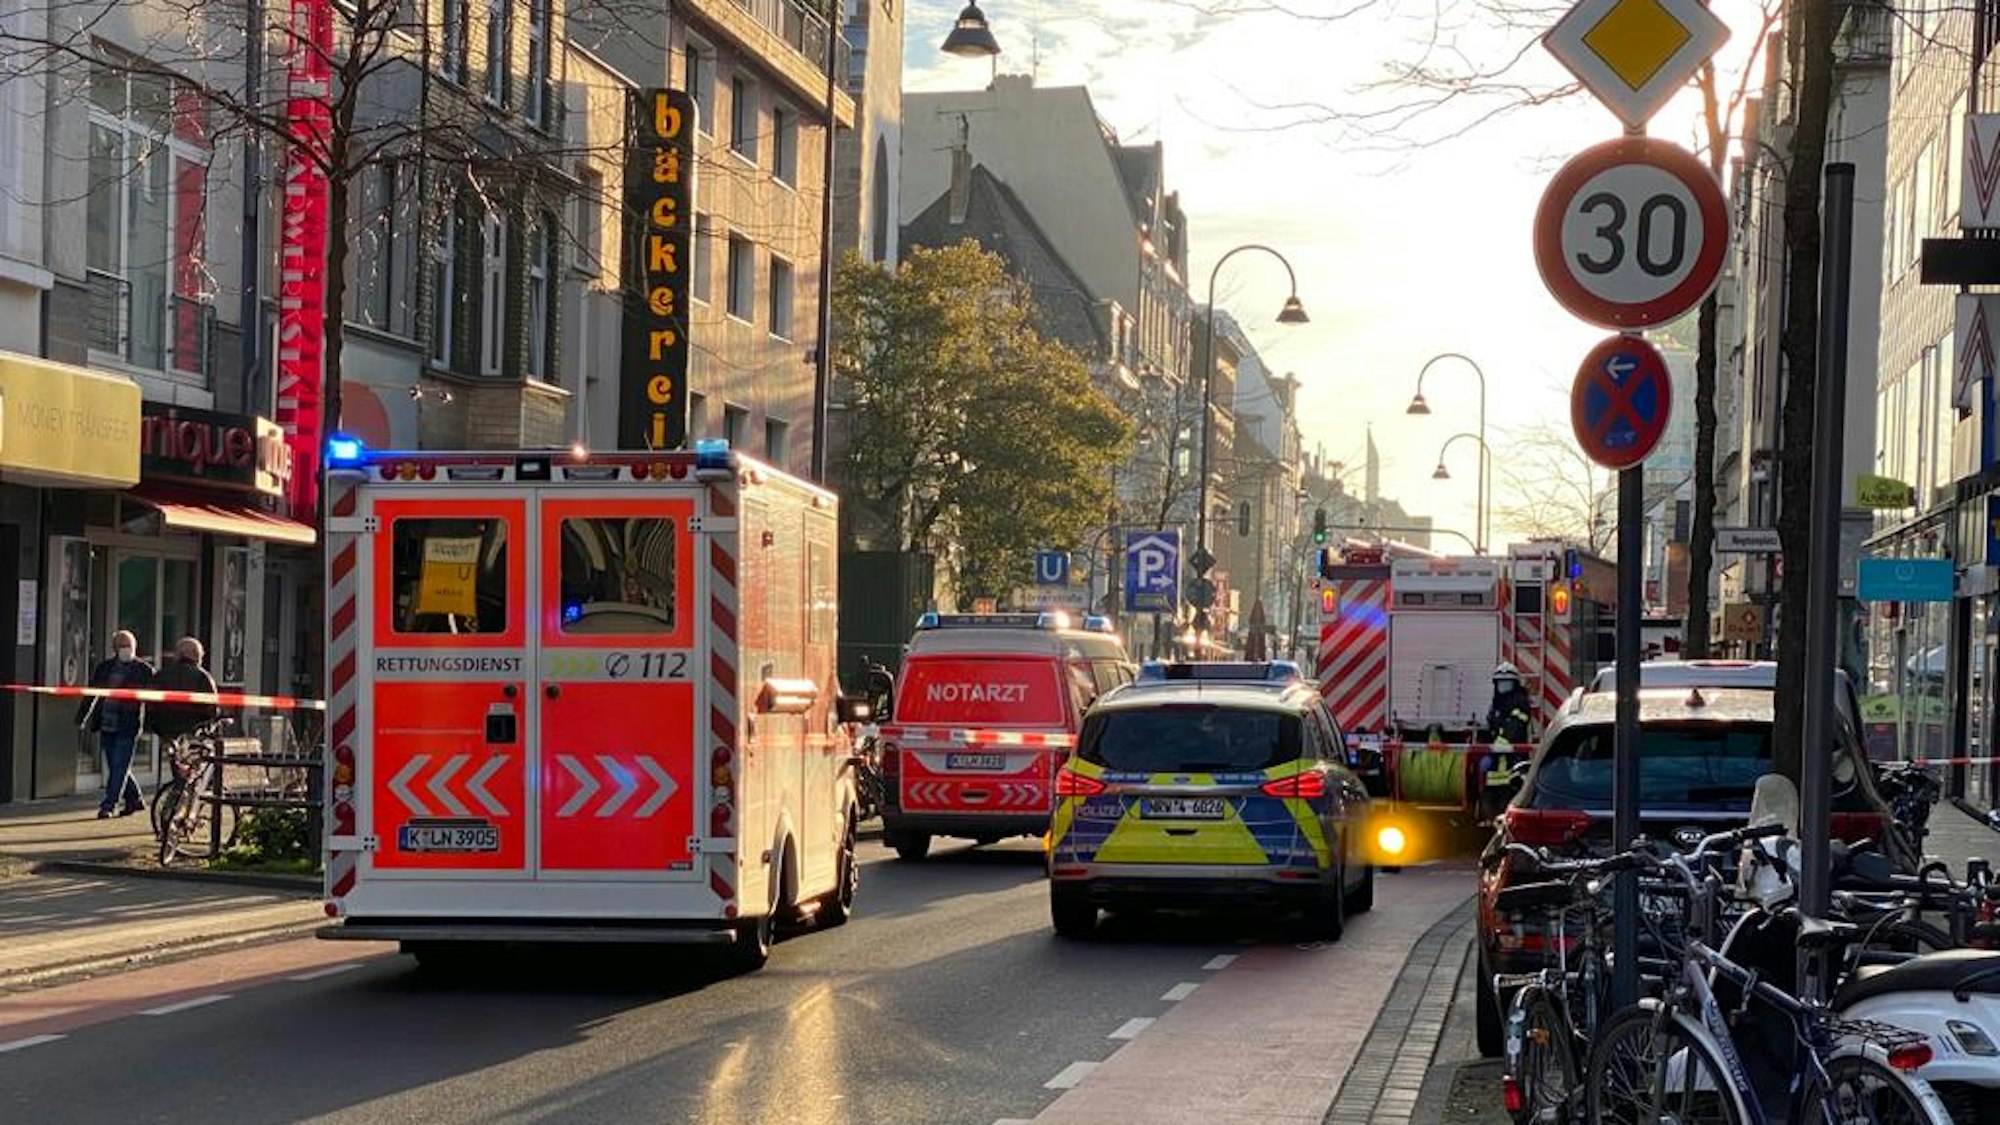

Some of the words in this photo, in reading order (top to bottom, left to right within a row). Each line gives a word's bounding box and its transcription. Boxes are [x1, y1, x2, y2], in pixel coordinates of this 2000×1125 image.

[1577, 192, 1686, 277] 30
[647, 93, 681, 448] bäckerei
[16, 401, 64, 436] MONEY
[1042, 556, 1061, 581] U
[1138, 550, 1165, 588] P
[376, 656, 522, 672] RETTUNGSDIENST
[640, 652, 687, 678] 112
[926, 683, 1029, 702] NOTARZT
[409, 829, 419, 845] K
[455, 829, 495, 846] 3905
